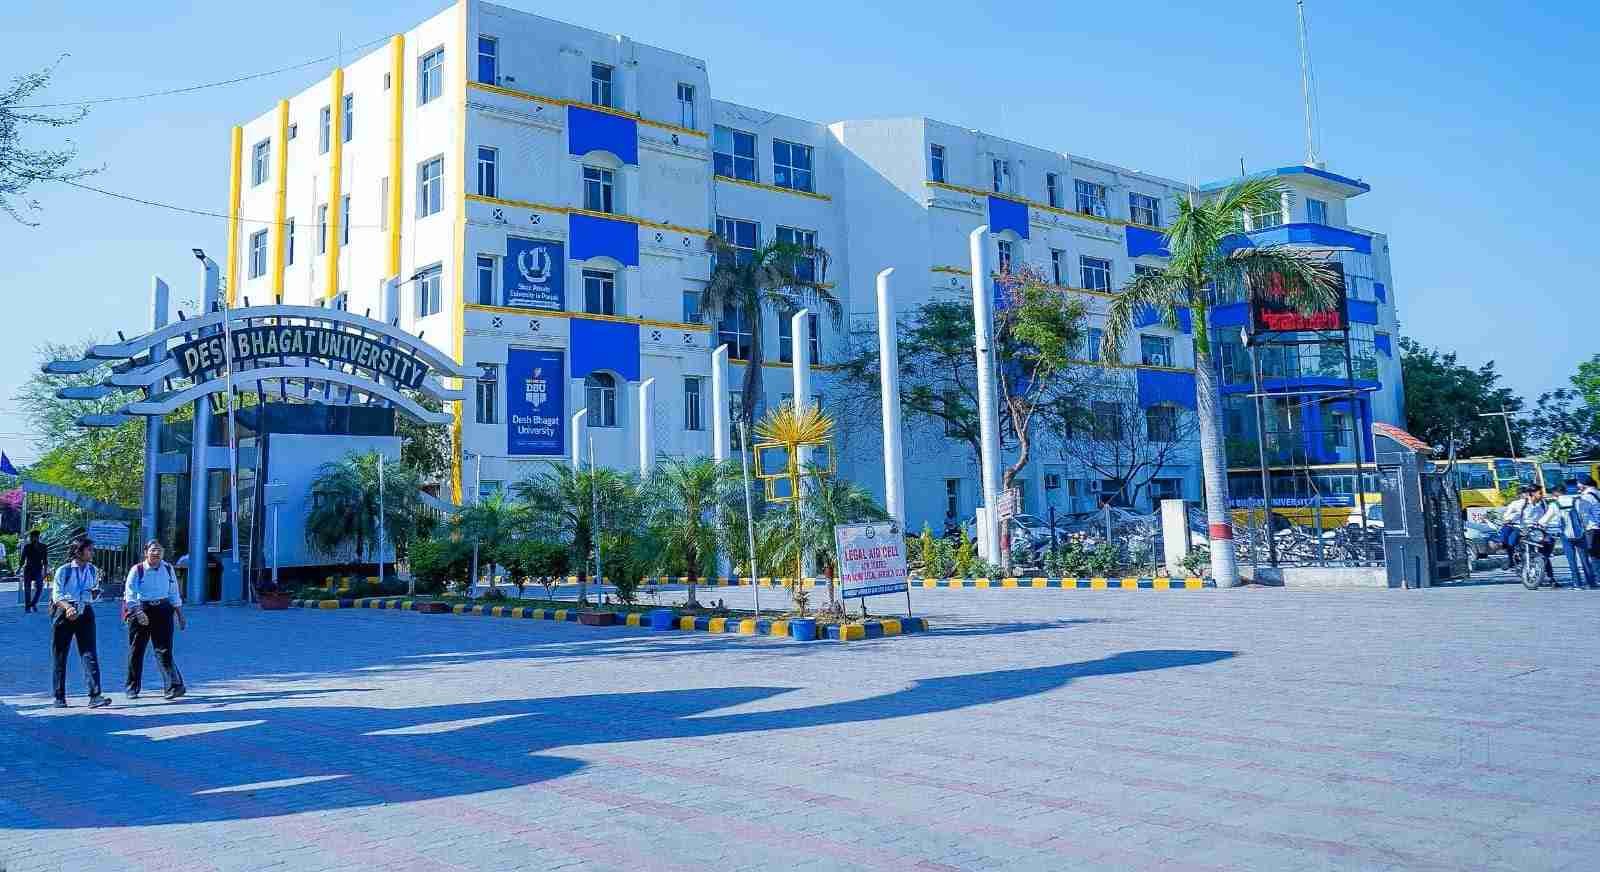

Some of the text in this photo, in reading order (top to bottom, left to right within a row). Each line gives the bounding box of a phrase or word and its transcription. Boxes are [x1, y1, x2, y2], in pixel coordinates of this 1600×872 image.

[238, 329, 315, 358] BHAGAT
[318, 330, 423, 386] UNIVERSITY
[512, 415, 559, 426] Desh Bhagat
[518, 425, 554, 437] University
[845, 548, 868, 562] LEGAL
[882, 546, 900, 559] CELL
